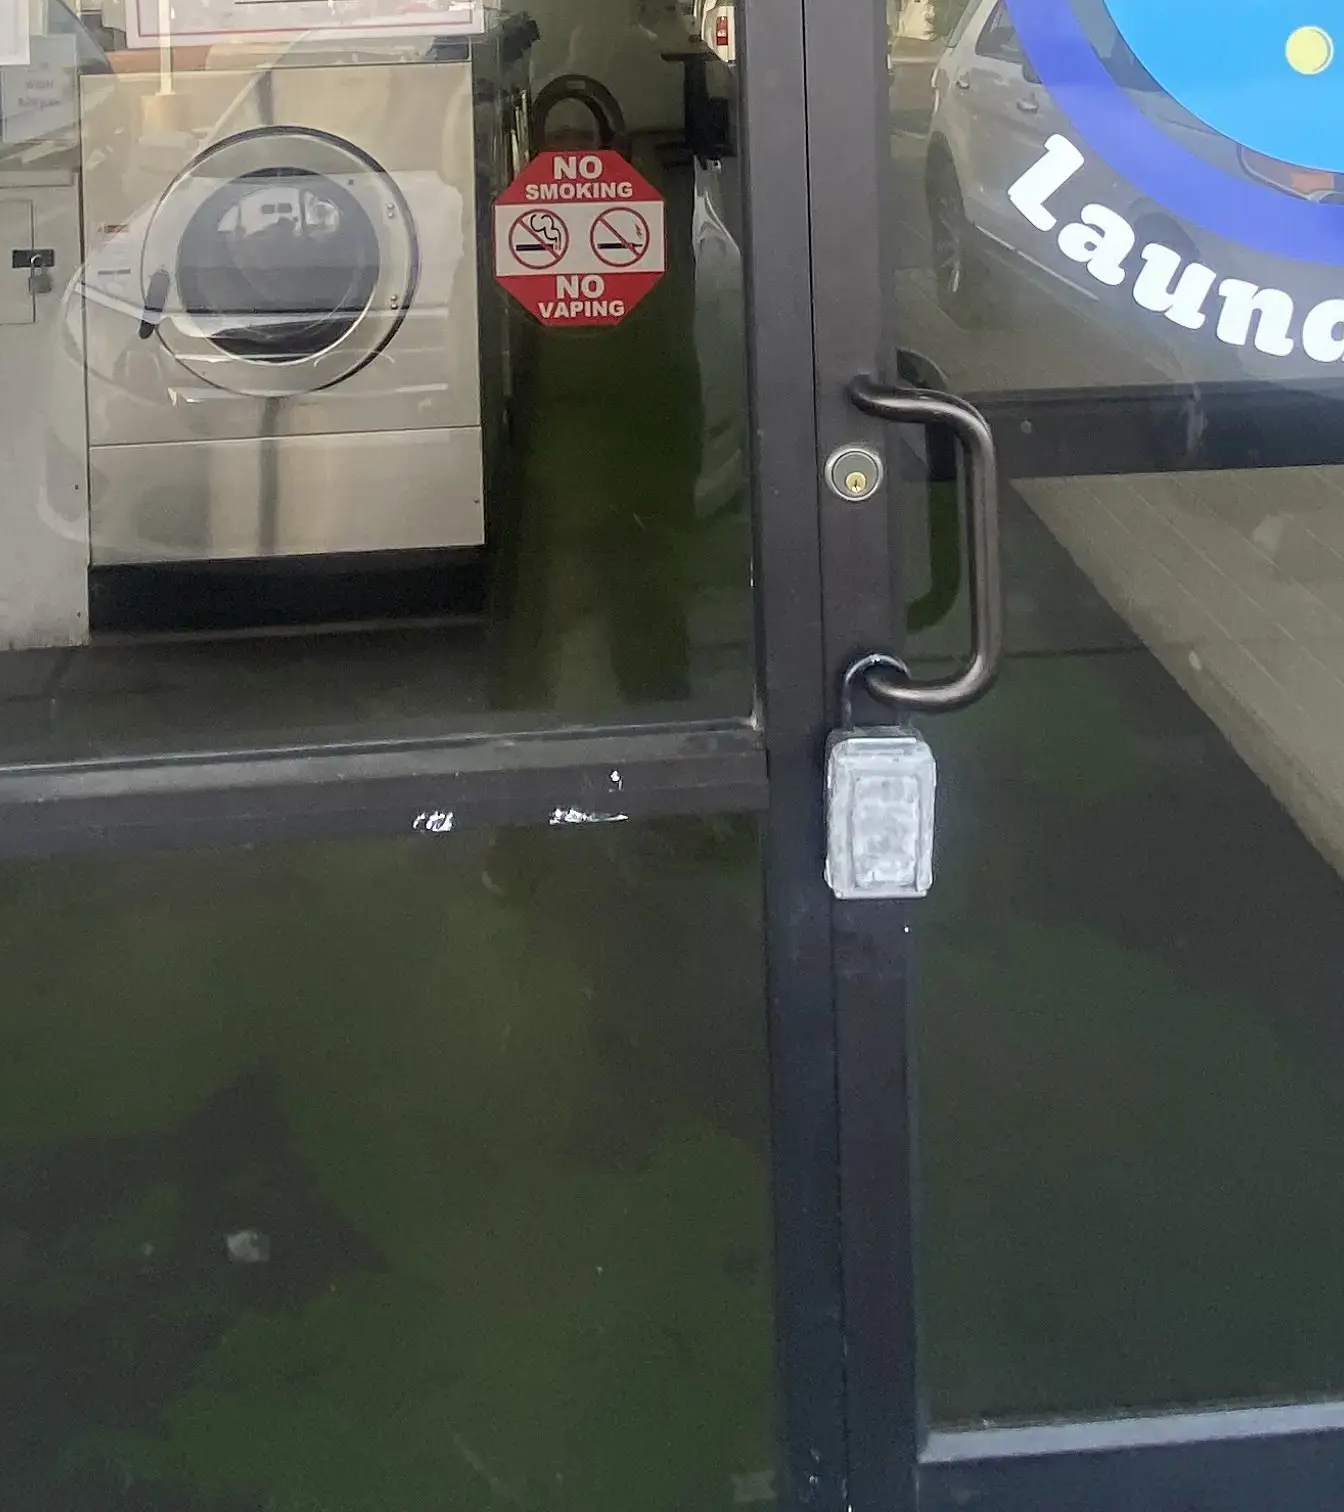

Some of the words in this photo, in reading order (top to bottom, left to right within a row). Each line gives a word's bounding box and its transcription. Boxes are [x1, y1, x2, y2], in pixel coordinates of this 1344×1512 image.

[553, 155, 603, 180] NO
[525, 181, 633, 200] SMOKING
[556, 274, 605, 299] NO
[538, 300, 625, 319] VAPING
